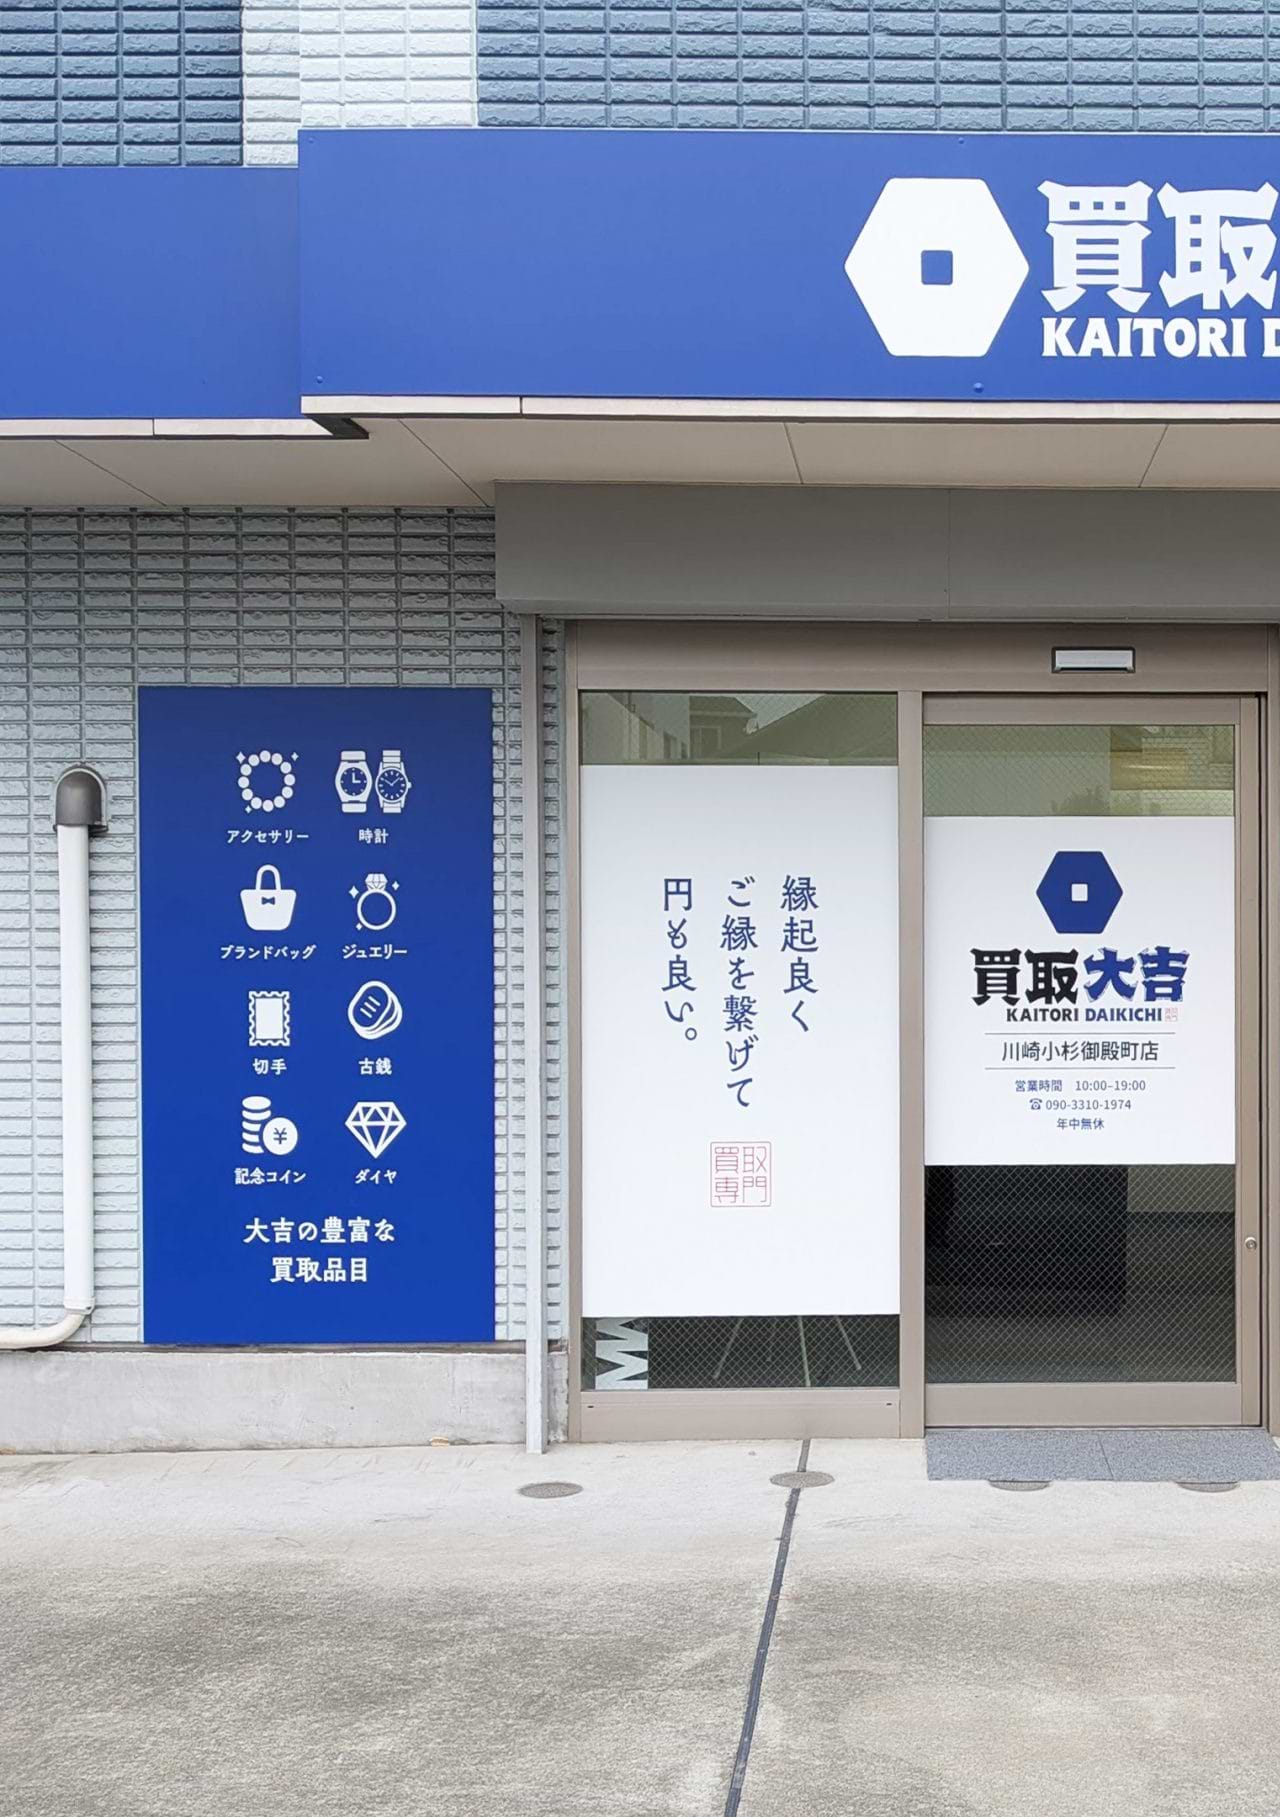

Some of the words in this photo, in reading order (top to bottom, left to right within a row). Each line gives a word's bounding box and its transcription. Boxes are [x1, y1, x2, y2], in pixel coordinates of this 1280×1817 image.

[1041, 317, 1248, 358] KAITORI
[227, 829, 309, 844] アクセサリー
[358, 828, 389, 844] 時計
[220, 944, 317, 960] ブランドバッグ
[342, 943, 408, 960] ジュエリー
[661, 878, 698, 1041] 円も良い。
[780, 874, 820, 1033] 縁起良く
[969, 946, 1190, 1006] 買取大吉
[719, 875, 759, 1108] ご縁を繋げて
[1006, 1007, 1079, 1022] KAITORI
[1085, 1007, 1162, 1022] DAIKICHI
[1001, 1040, 1159, 1062] 川崎小杉御殿町店
[252, 1057, 288, 1076] 切手
[358, 1057, 393, 1076] 古銭
[1015, 1079, 1063, 1092] 営業時間
[1045, 1099, 1132, 1111] 090-3310-1974
[1056, 1117, 1105, 1130] 年中無休
[233, 1167, 307, 1185] 記念コイン
[355, 1168, 397, 1185] ダイヤ
[243, 1215, 396, 1244] 大吉の豊富な
[269, 1256, 368, 1283] 買取品目
